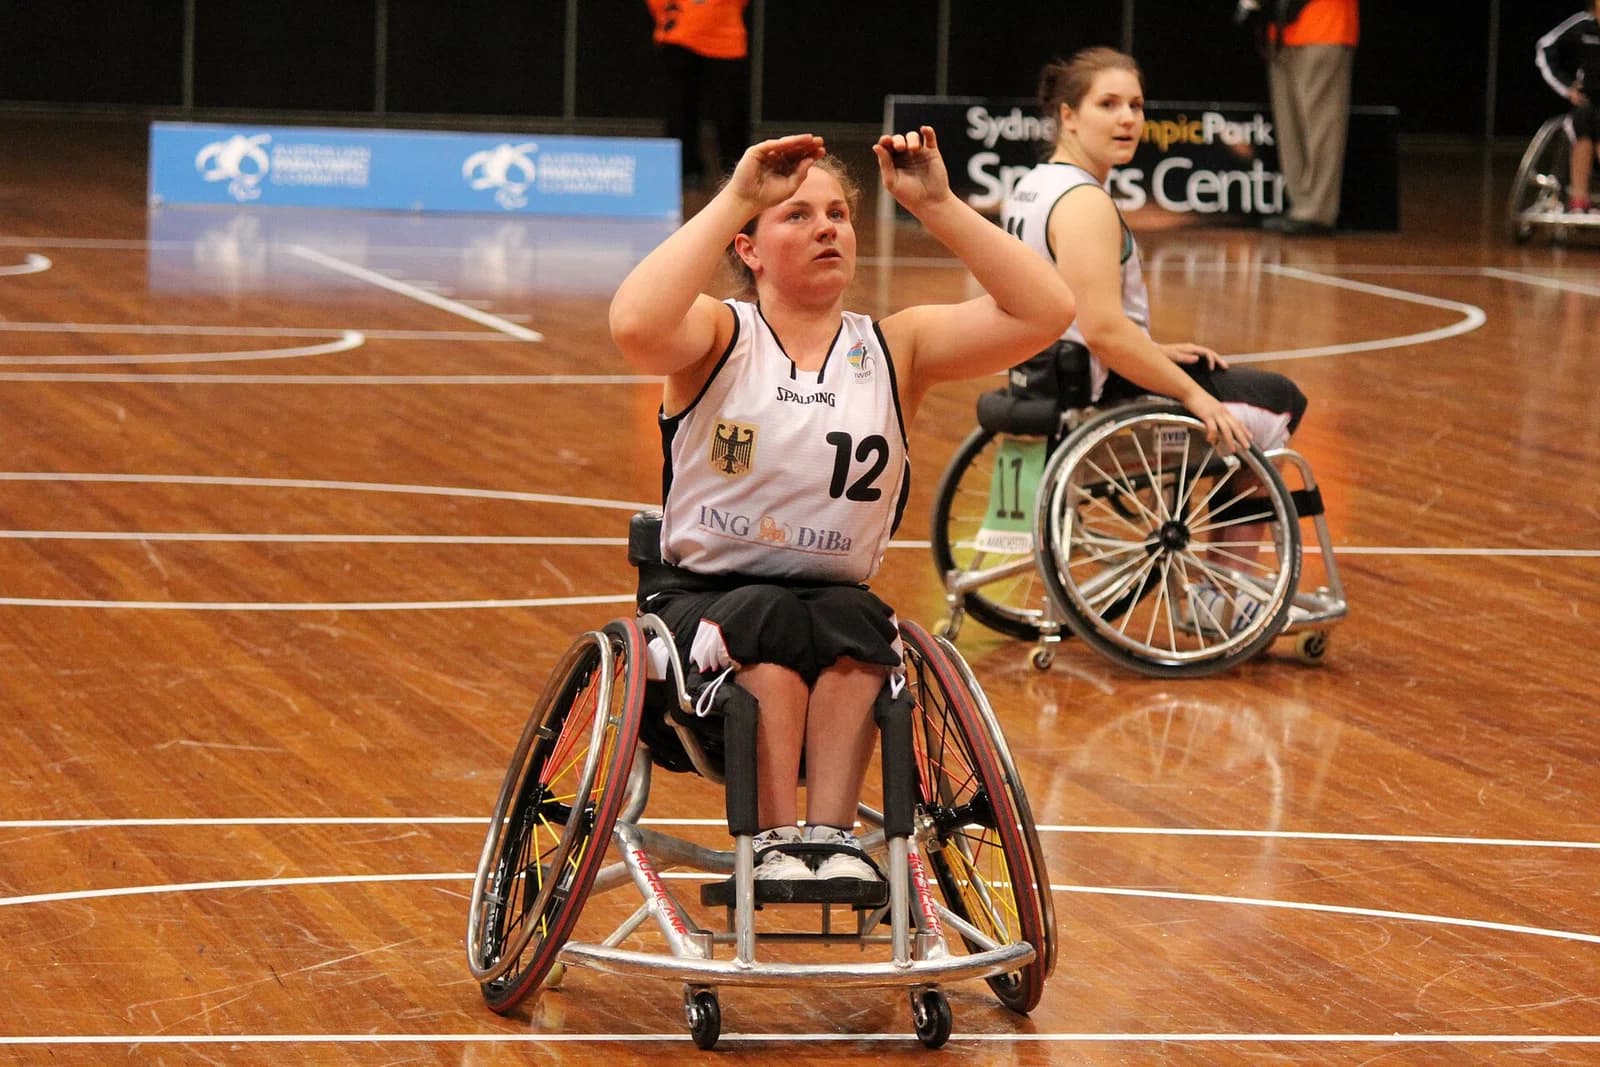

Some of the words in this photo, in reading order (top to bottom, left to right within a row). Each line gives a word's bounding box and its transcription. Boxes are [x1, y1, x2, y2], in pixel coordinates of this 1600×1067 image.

[966, 105, 1058, 149] Sydne
[1152, 156, 1287, 213] Centr
[776, 386, 836, 407] SPALDING
[826, 431, 889, 502] 12
[996, 456, 1025, 520] 11
[699, 505, 750, 537] ING
[797, 526, 853, 552] DiBa
[632, 849, 689, 936] HURRICANE
[907, 852, 944, 938] HURRICANE
